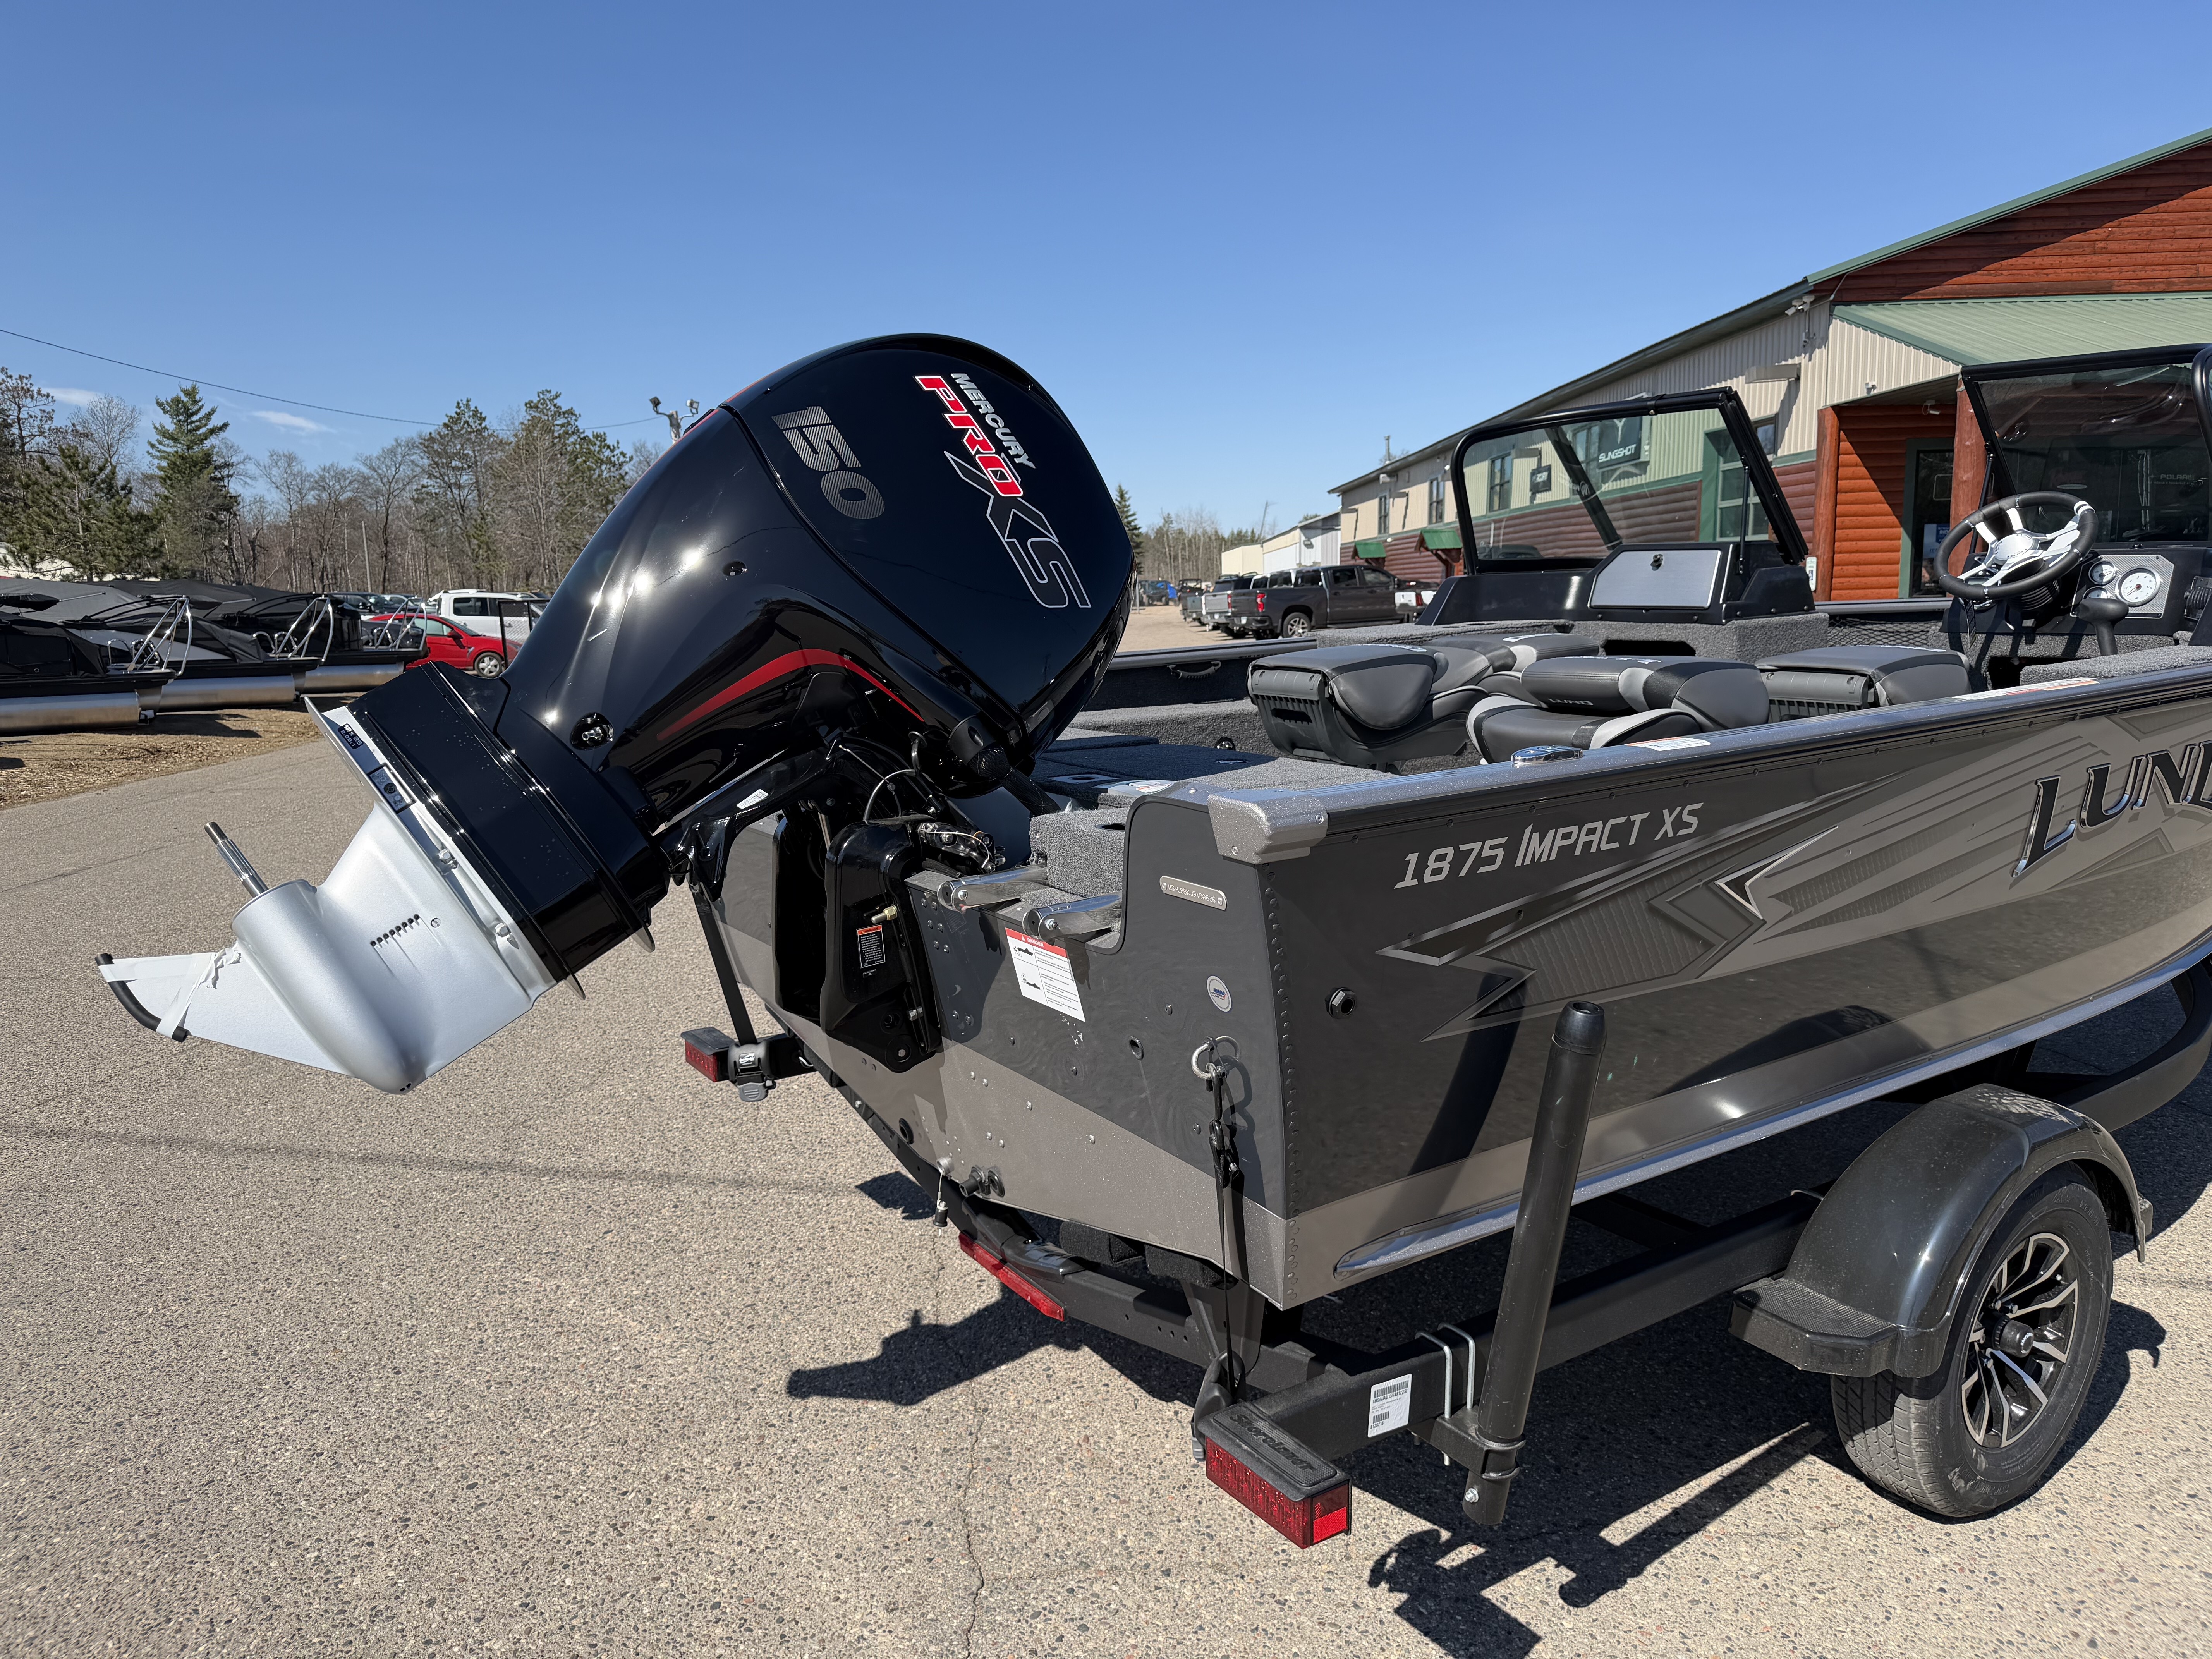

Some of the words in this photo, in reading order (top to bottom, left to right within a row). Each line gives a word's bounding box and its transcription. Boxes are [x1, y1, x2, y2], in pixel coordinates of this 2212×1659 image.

[771, 406, 884, 519] 150
[914, 376, 1023, 496] PRO
[951, 373, 1035, 469] MERCURY
[1598, 444, 1637, 463] SLINGSHOT
[944, 451, 1091, 608] XS
[1394, 836, 1509, 889] 1875
[1515, 812, 1650, 867] IMPACT
[1654, 802, 1704, 841] XS
[1027, 936, 1044, 948] DANGER
